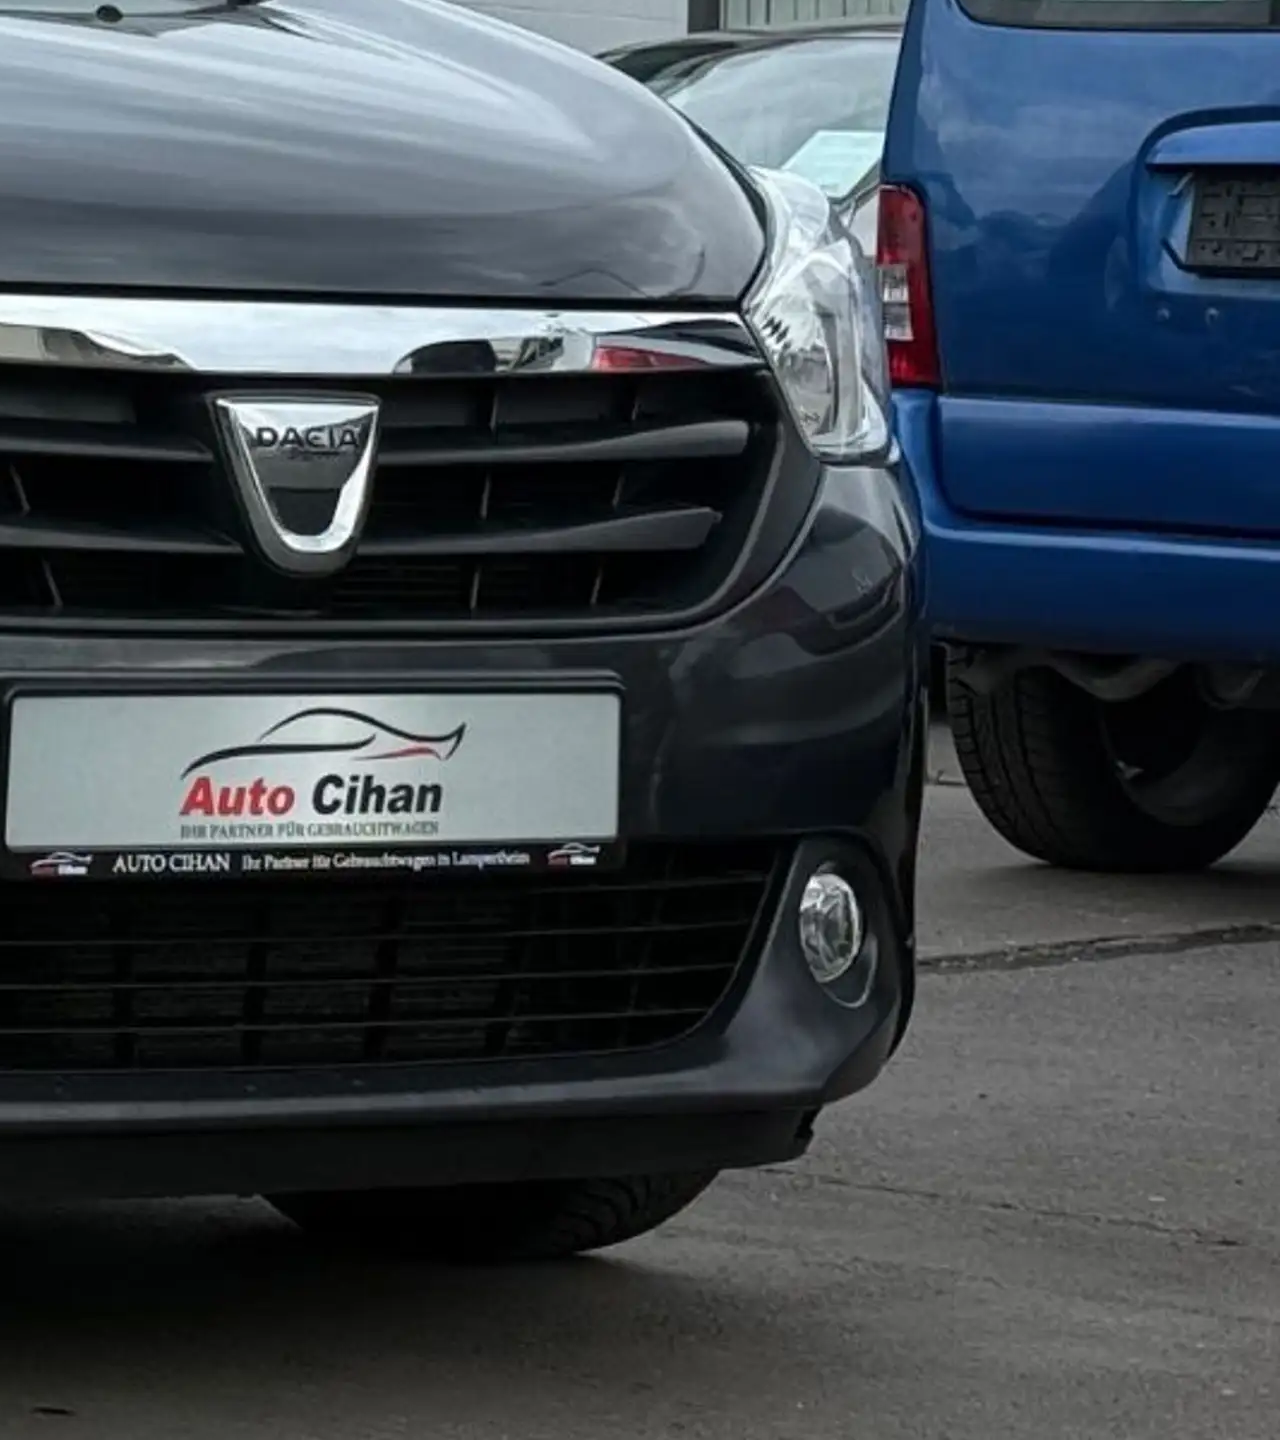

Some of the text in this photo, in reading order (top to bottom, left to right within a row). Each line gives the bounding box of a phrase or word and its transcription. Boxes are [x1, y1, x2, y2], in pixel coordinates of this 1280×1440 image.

[256, 425, 359, 448] DACIA
[180, 775, 442, 816] Auto Cihan
[180, 819, 439, 840] IHR PARTNER FÜR GEBRAUCHTWAGEN
[112, 855, 166, 873] AUTO
[168, 853, 230, 872] CIHAN
